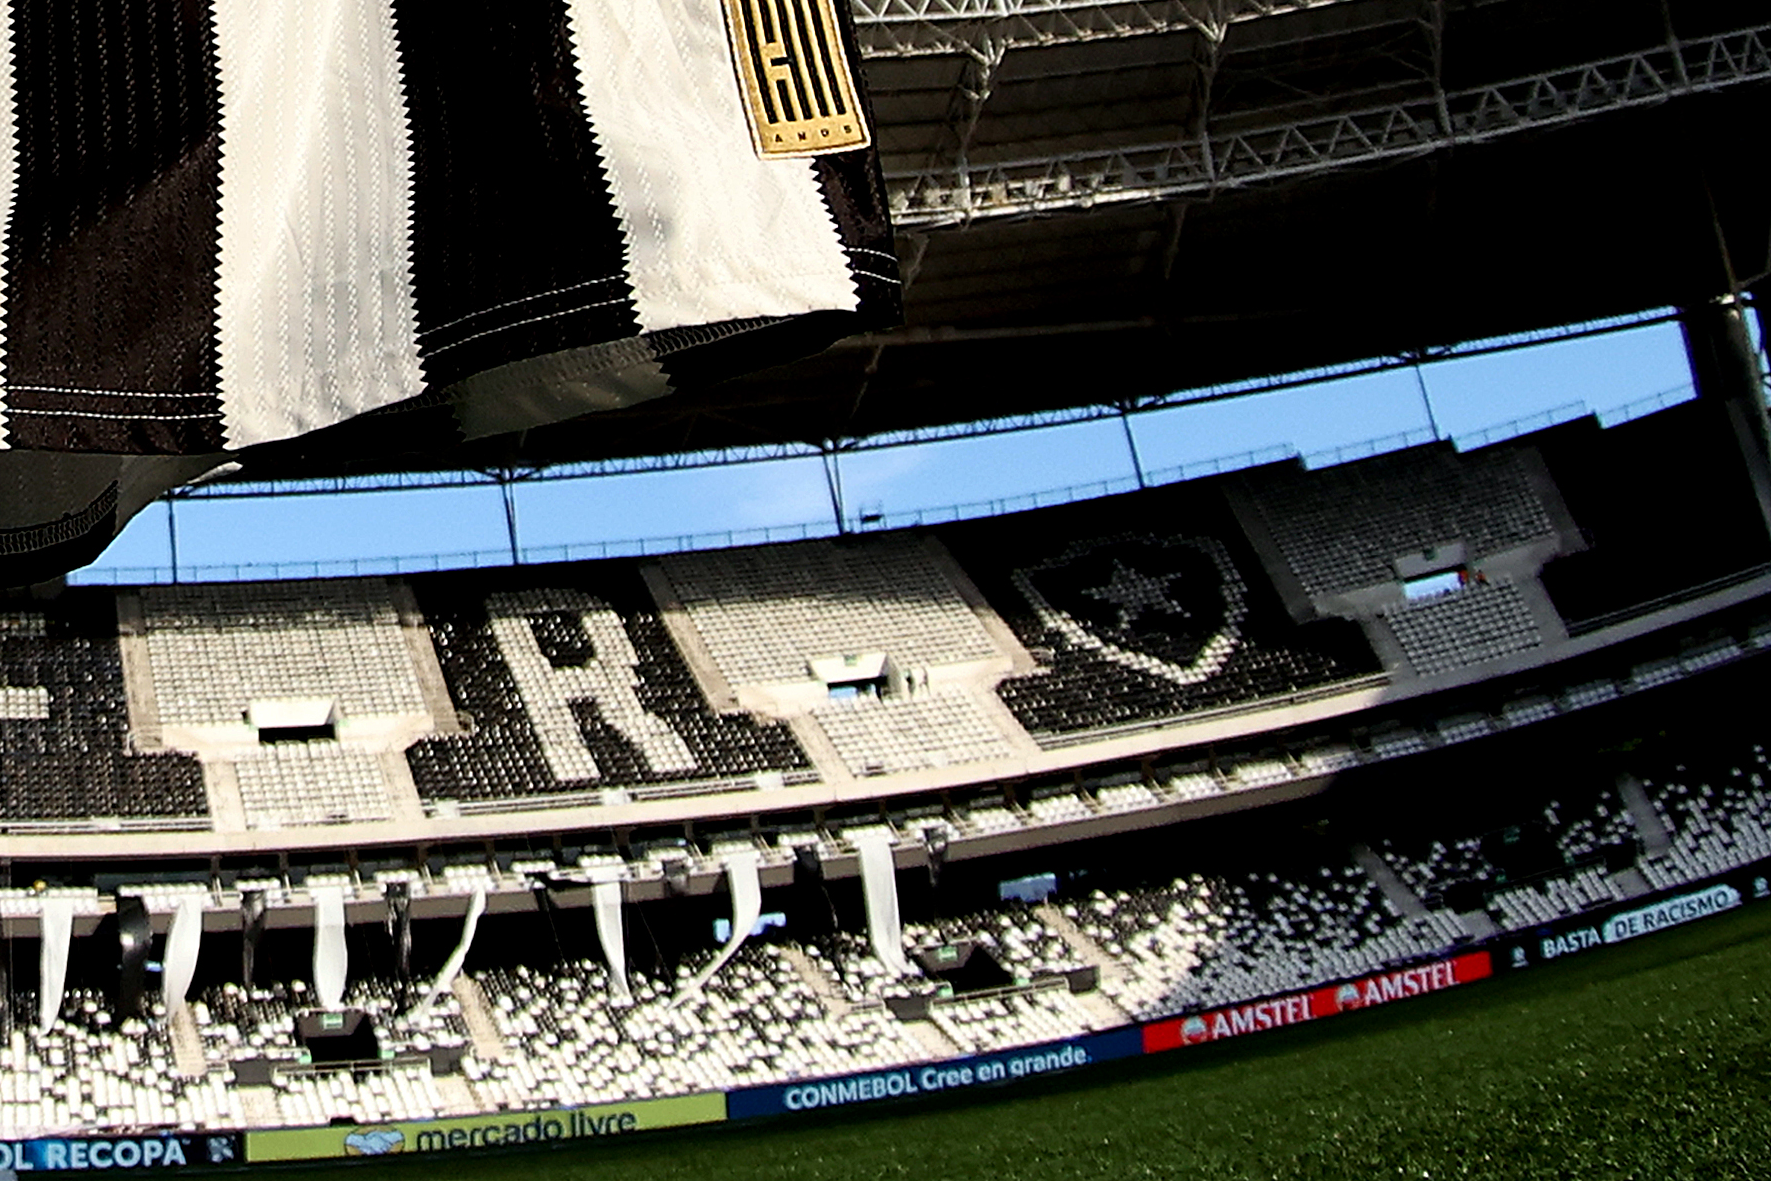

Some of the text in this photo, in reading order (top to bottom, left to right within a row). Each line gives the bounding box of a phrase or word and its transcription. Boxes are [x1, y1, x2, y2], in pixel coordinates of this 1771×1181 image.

[1541, 889, 1729, 959] BASTA DE RACISMO
[1364, 960, 1459, 1006] AMSTEL
[1212, 994, 1314, 1040] AMSTEL
[785, 1071, 918, 1110] CONMEBOL
[921, 1066, 974, 1091] Cree
[977, 1062, 1006, 1082] en
[45, 1137, 187, 1168] RECOPA
[416, 1109, 637, 1152] mercado livre
